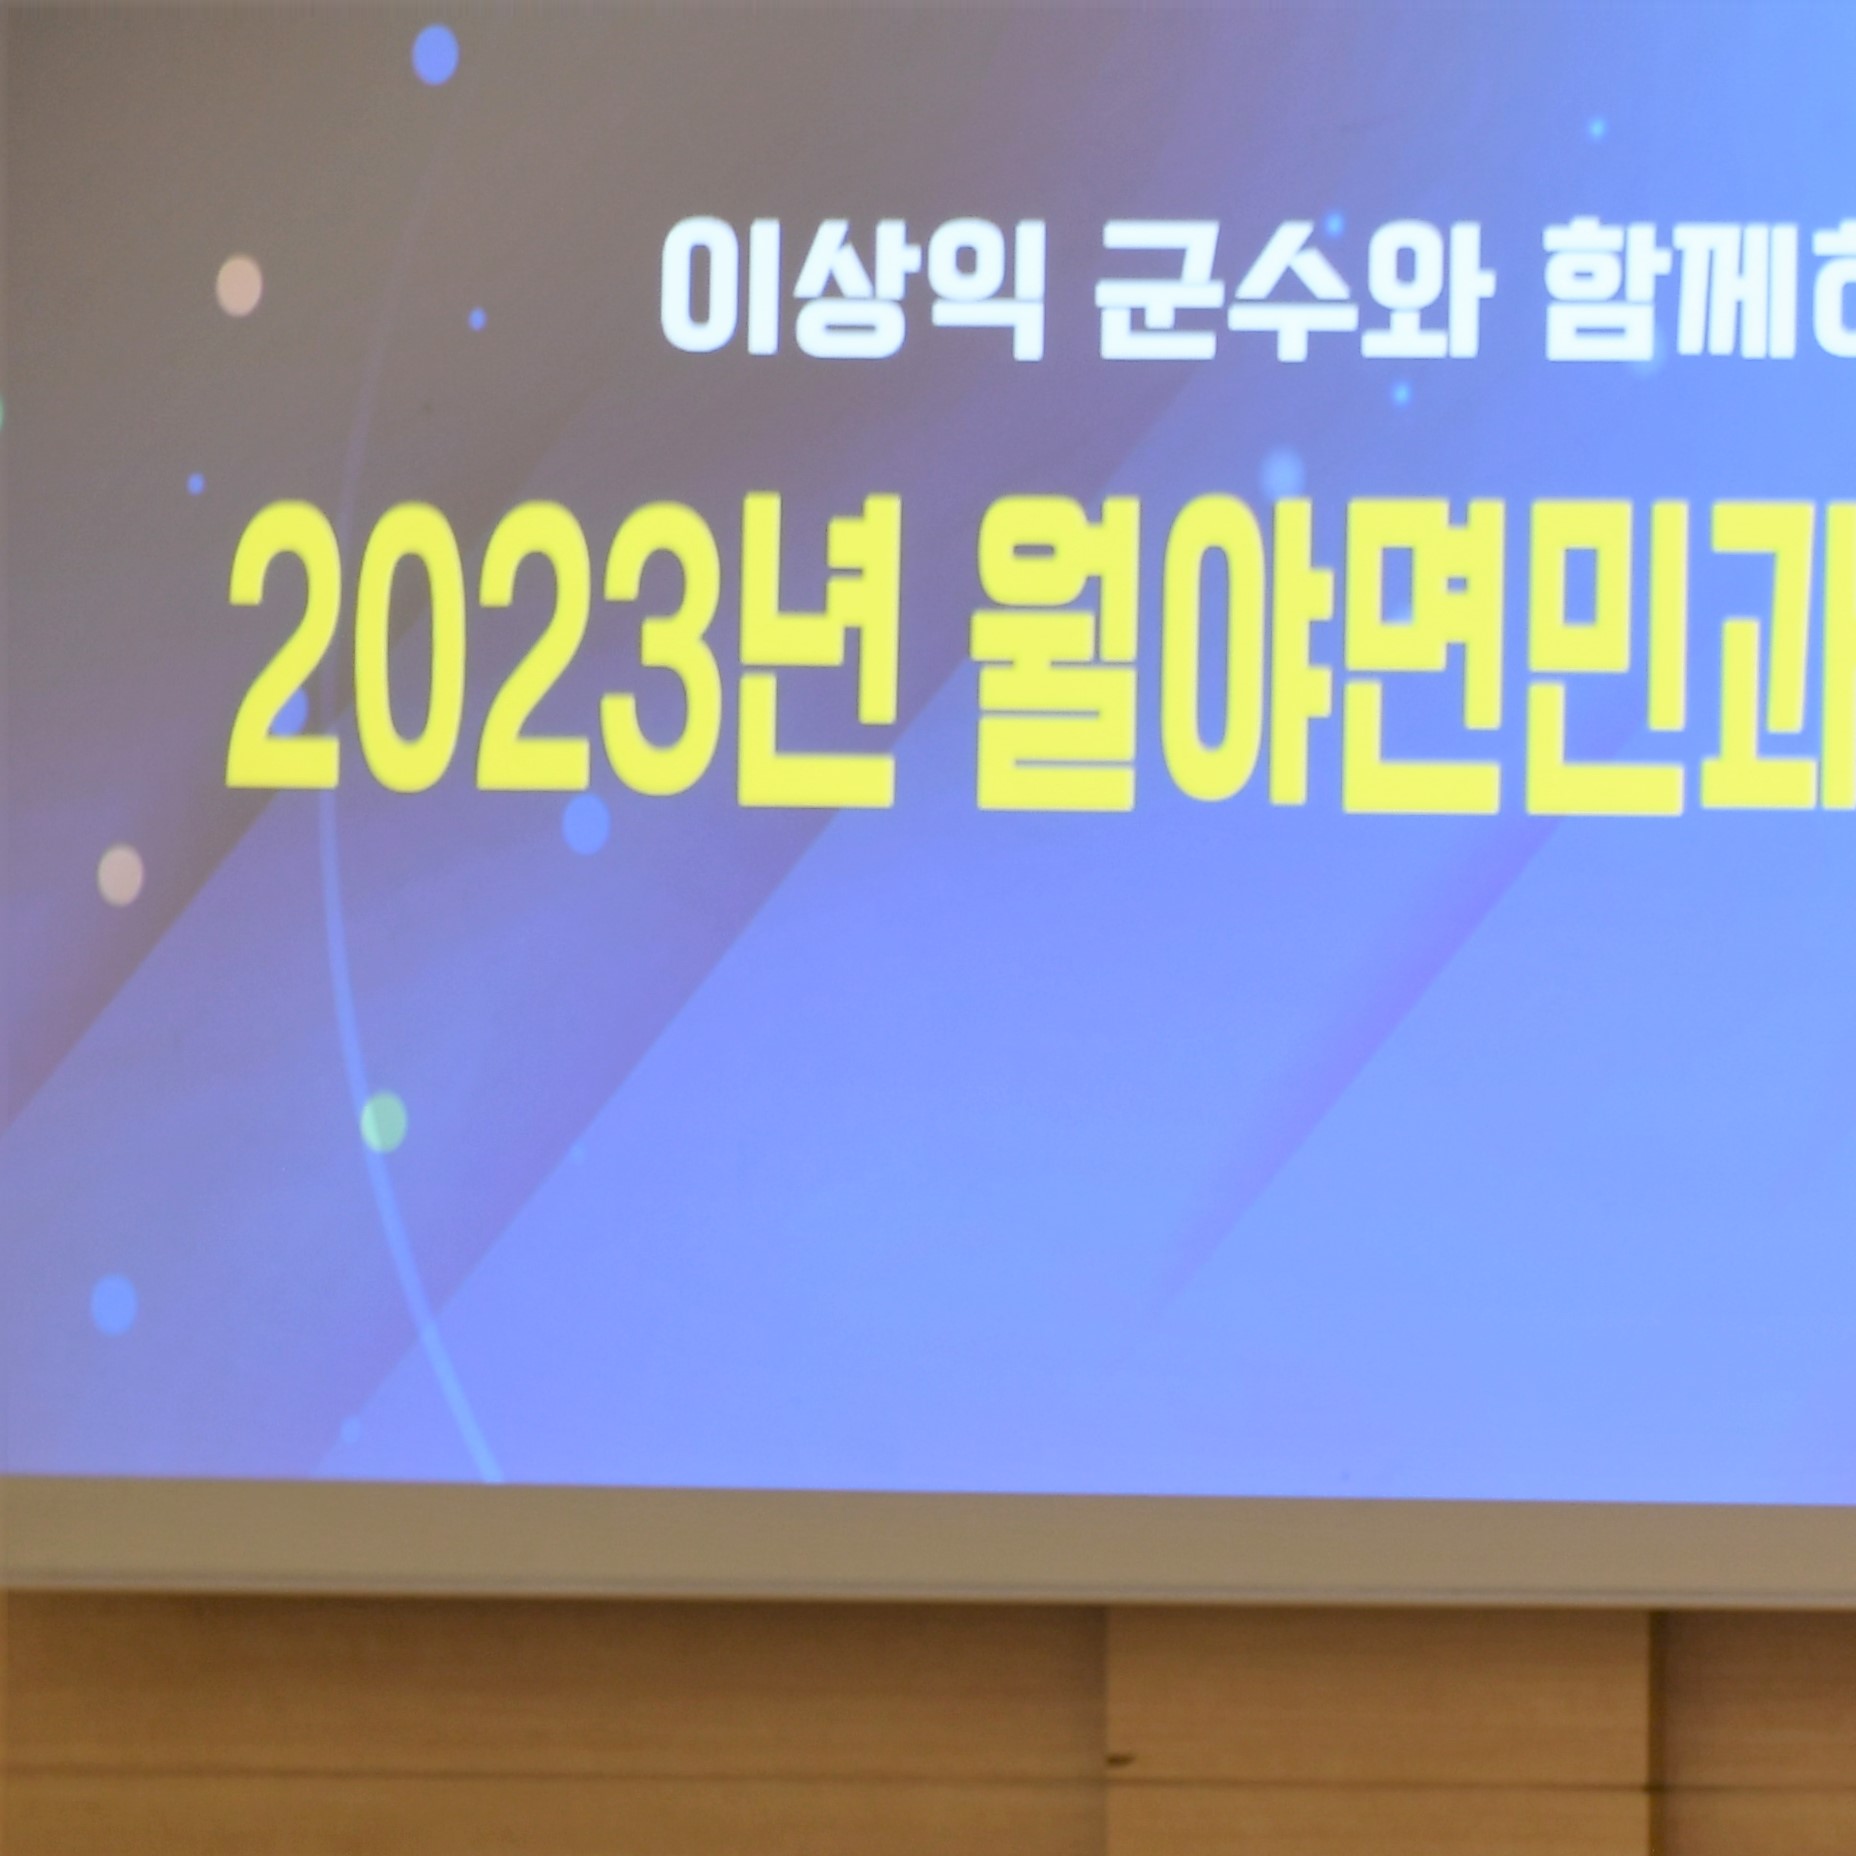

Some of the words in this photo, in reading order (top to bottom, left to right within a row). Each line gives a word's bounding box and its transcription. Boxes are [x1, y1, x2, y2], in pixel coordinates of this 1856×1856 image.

[661, 219, 1045, 360] 이상익
[1096, 223, 1495, 361] 군수와
[226, 492, 902, 808] 2023년
